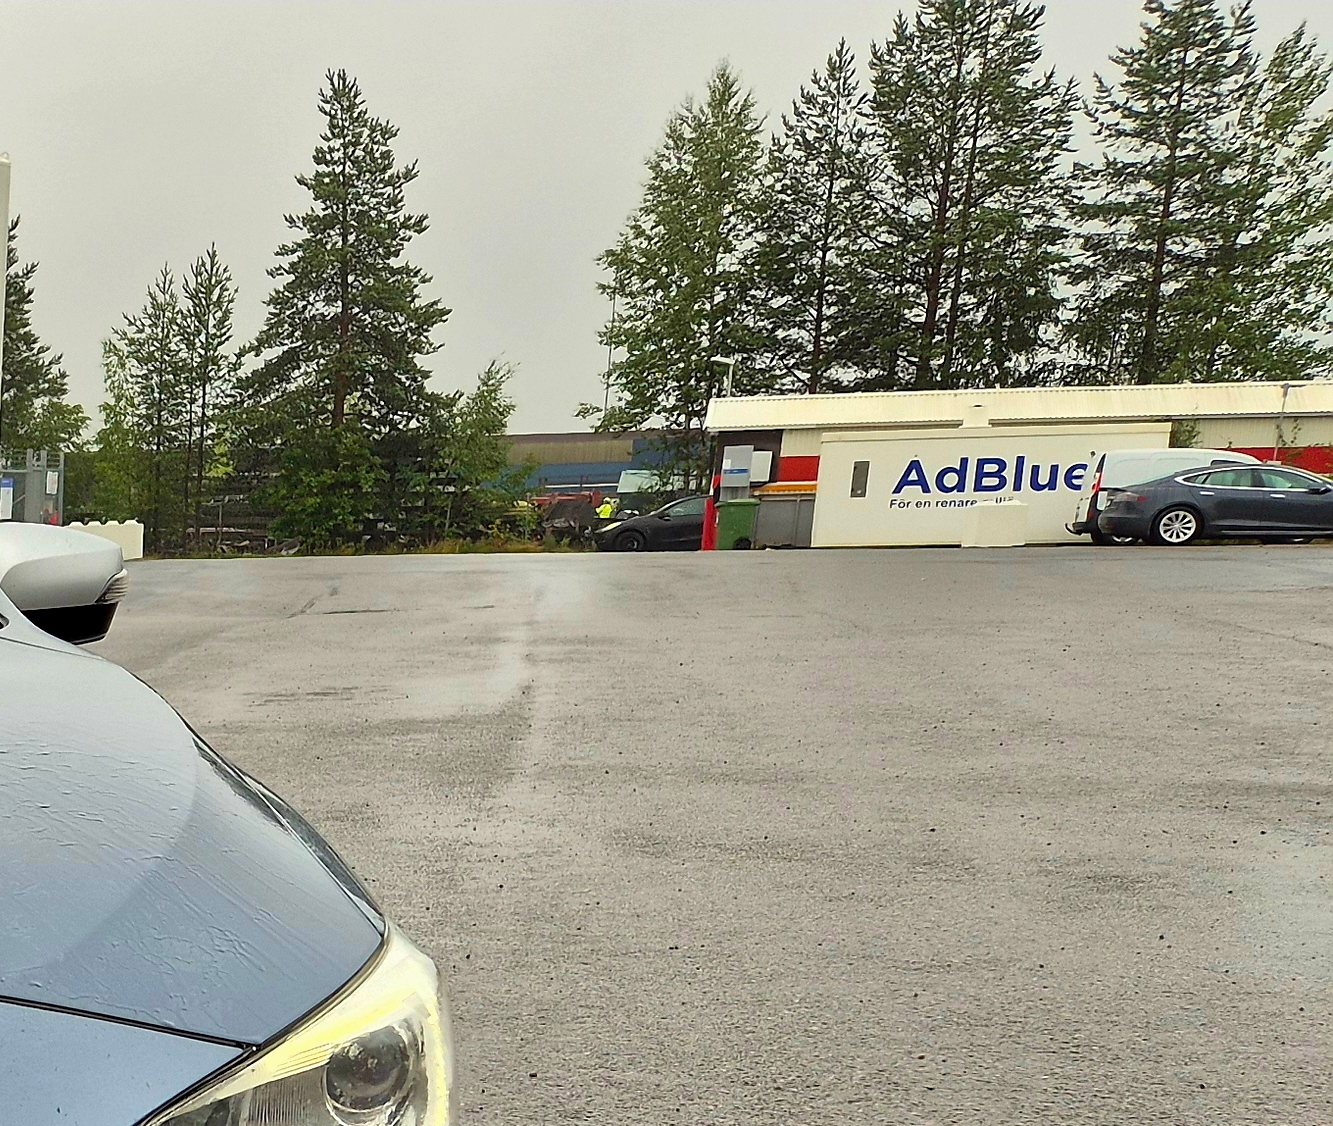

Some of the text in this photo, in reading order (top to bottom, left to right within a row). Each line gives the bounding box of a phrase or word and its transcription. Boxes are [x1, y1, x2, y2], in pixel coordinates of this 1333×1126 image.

[891, 455, 1088, 494] AdBlue
[889, 498, 911, 509] För
[915, 499, 931, 509] en
